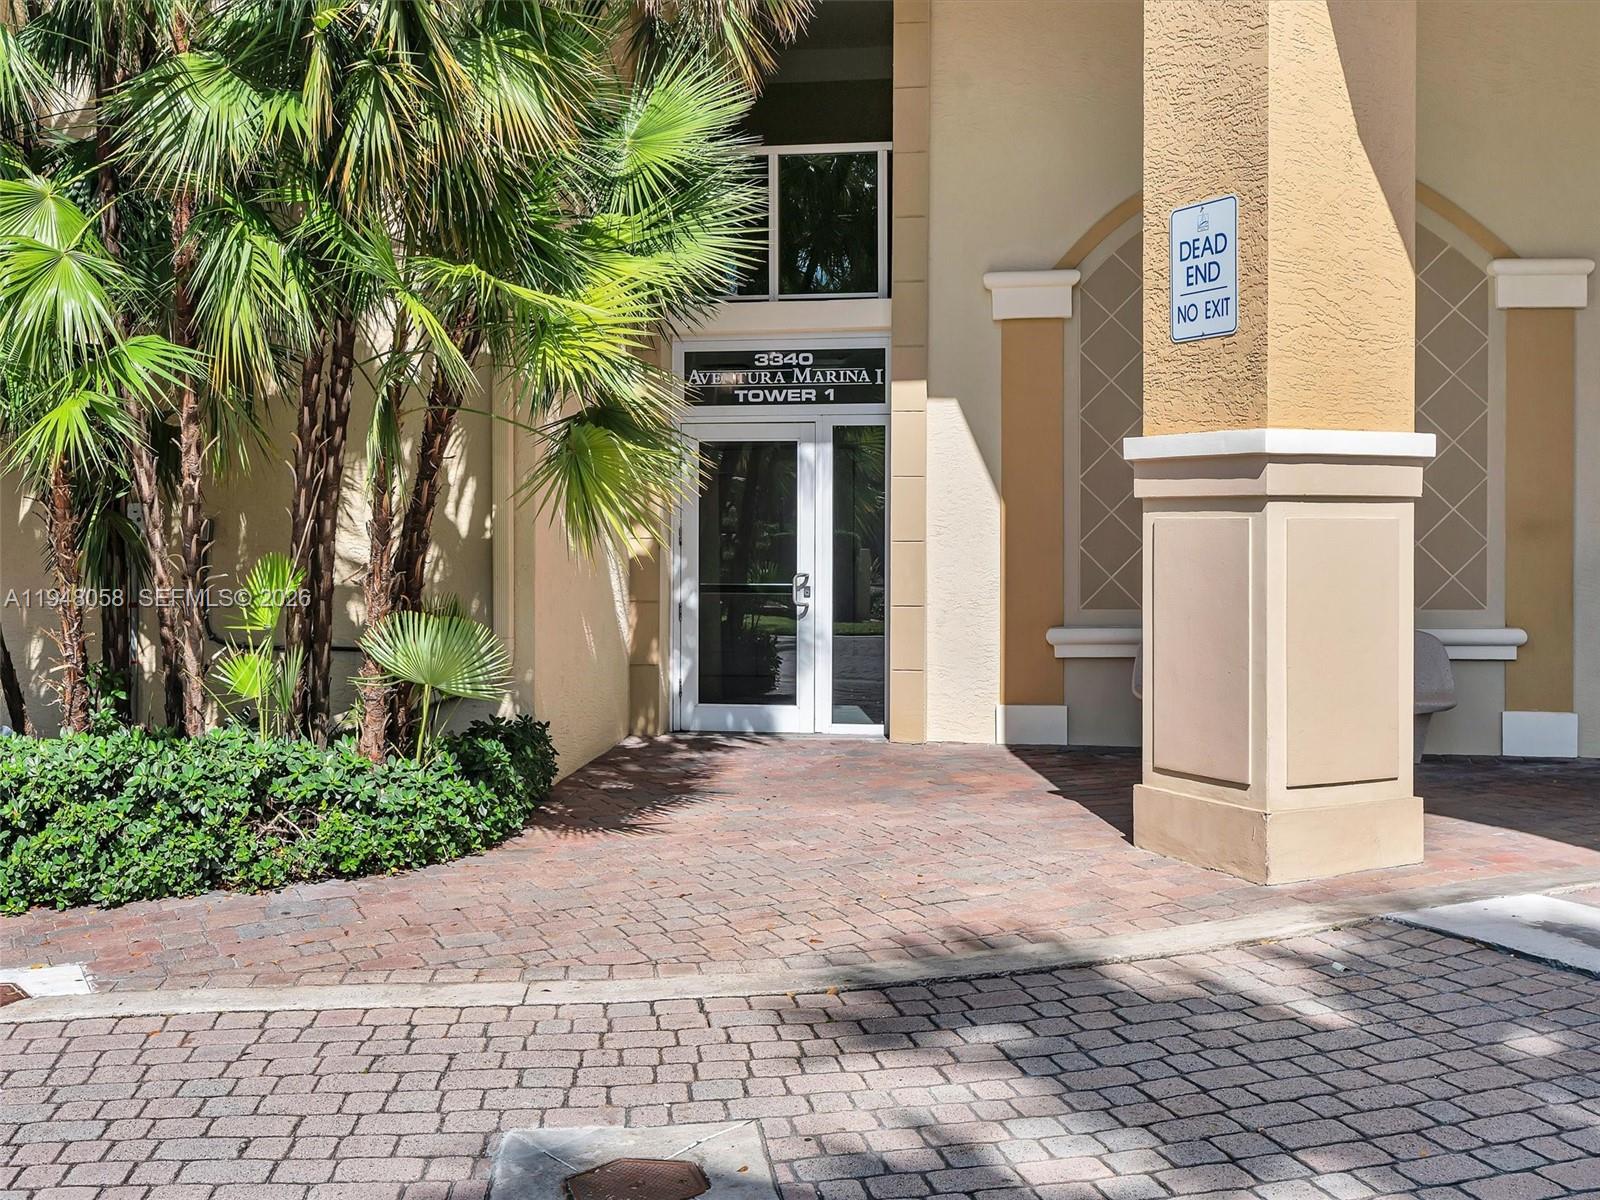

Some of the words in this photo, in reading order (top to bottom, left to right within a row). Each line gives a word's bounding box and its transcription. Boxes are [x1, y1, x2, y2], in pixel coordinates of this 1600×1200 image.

[1179, 232, 1228, 262] DEAD
[1186, 260, 1221, 287] END
[1177, 303, 1199, 324] NO
[1204, 297, 1231, 320] EXIT
[753, 352, 814, 366] 3340
[791, 367, 871, 384] MARINA
[874, 368, 884, 385] I
[734, 389, 817, 403] TOWER
[824, 388, 835, 401] 1
